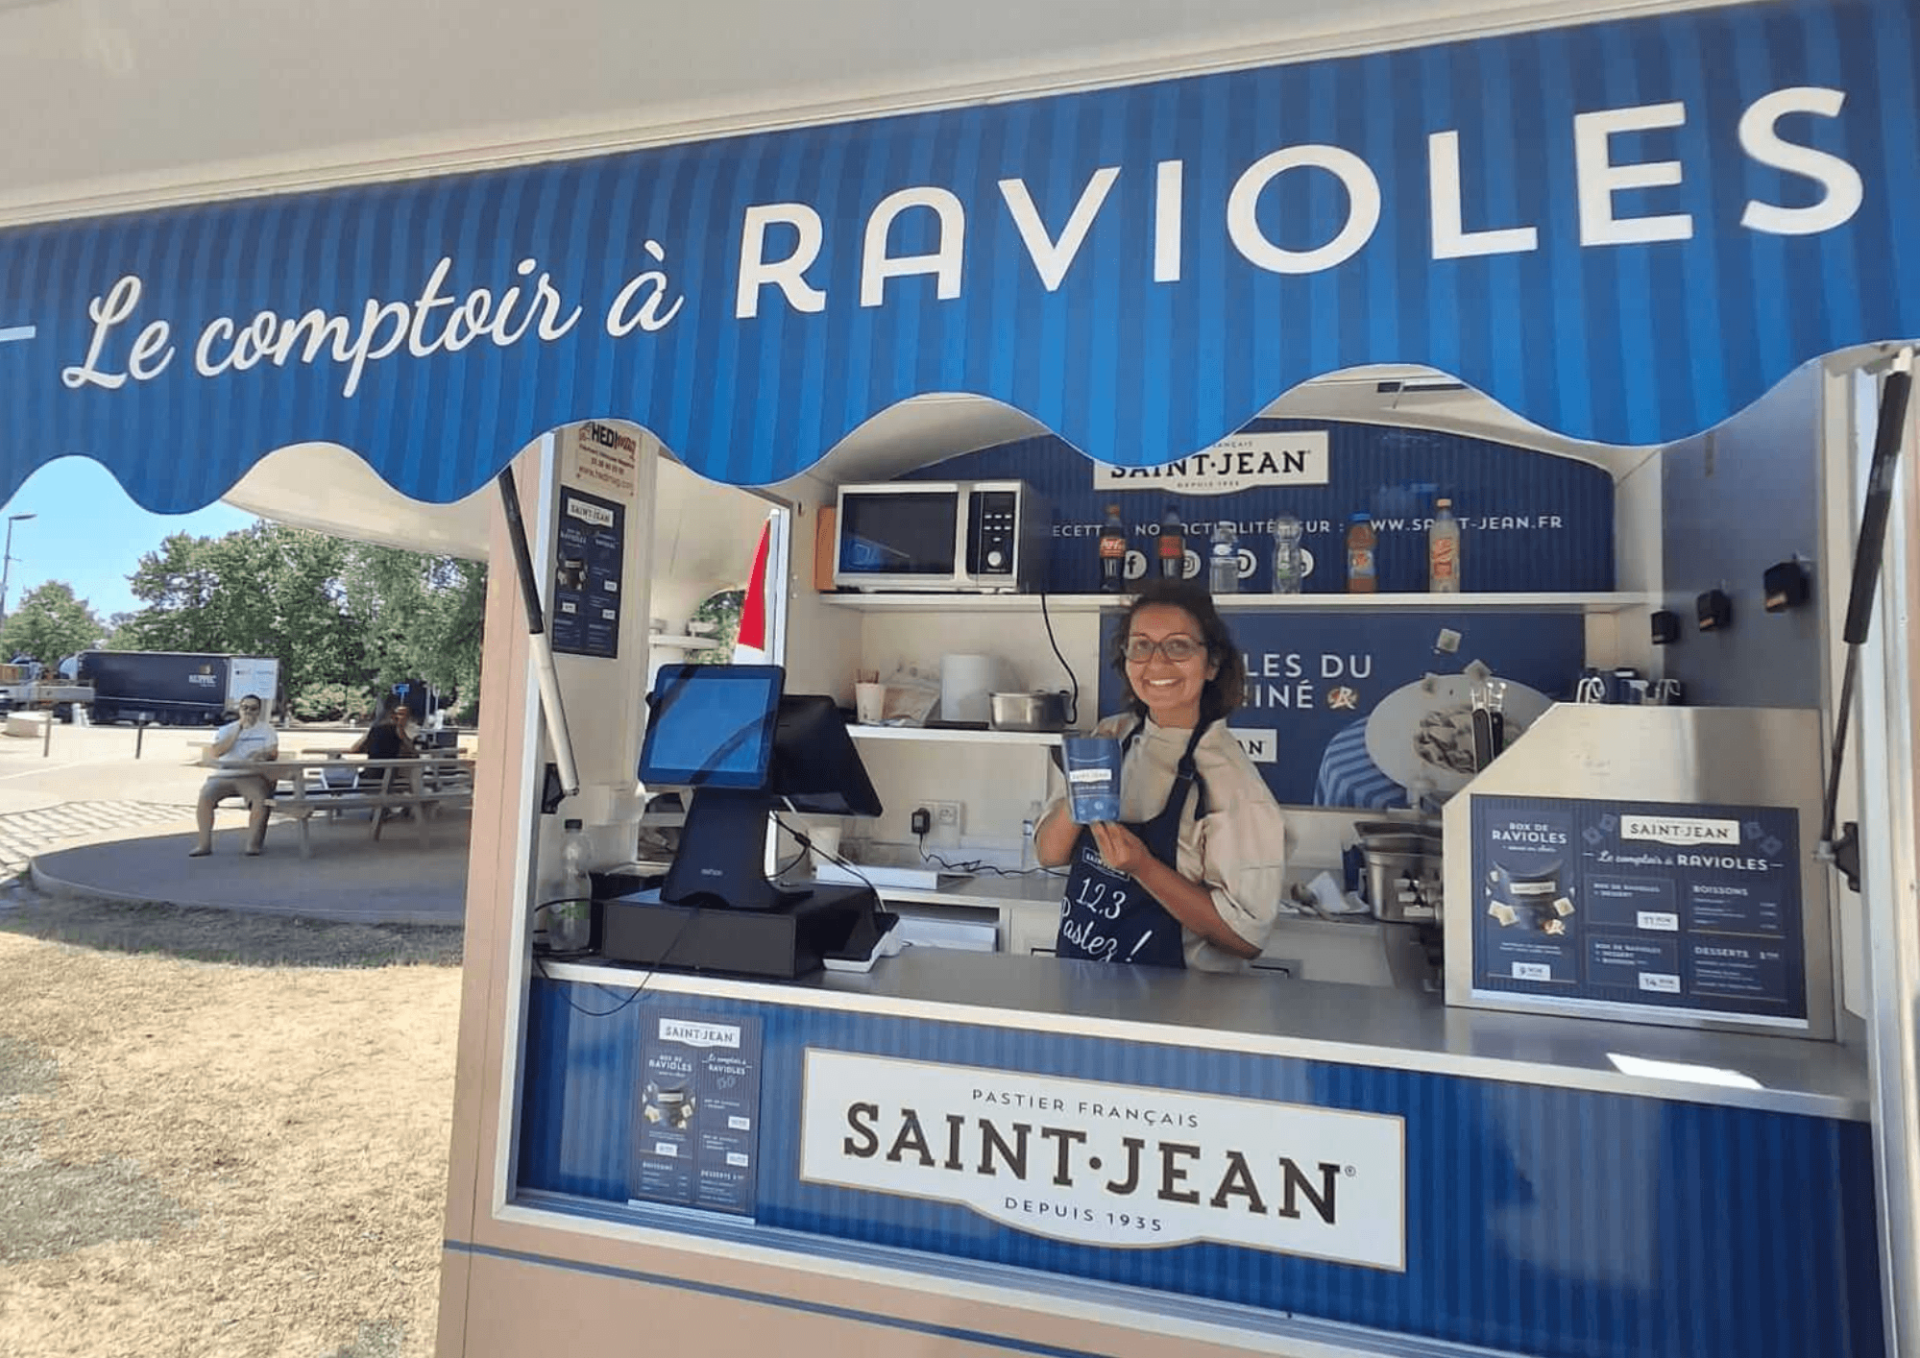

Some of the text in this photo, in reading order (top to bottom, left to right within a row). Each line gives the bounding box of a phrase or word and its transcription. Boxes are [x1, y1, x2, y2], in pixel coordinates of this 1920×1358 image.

[62, 86, 1864, 398] Le comptoir à RAVIOLES
[1052, 524, 1103, 537] ECETT
[1135, 524, 1161, 536] NO
[1298, 521, 1331, 534] UR
[1243, 653, 1371, 678] LES DU
[1242, 679, 1314, 708] INÉ
[1509, 822, 1549, 832] BOX DE
[1491, 829, 1567, 844] RAVIOLES
[1677, 854, 1768, 871] RAVIOLES
[1692, 885, 1748, 896] BOISSONS
[1126, 930, 1153, 962] !
[1694, 946, 1749, 958] DESSERTS
[648, 1059, 692, 1072] RAVIOLES
[972, 1089, 1199, 1128] PASTIER FRANÇAIS
[1005, 1197, 1163, 1232] DEPUIS 1935
